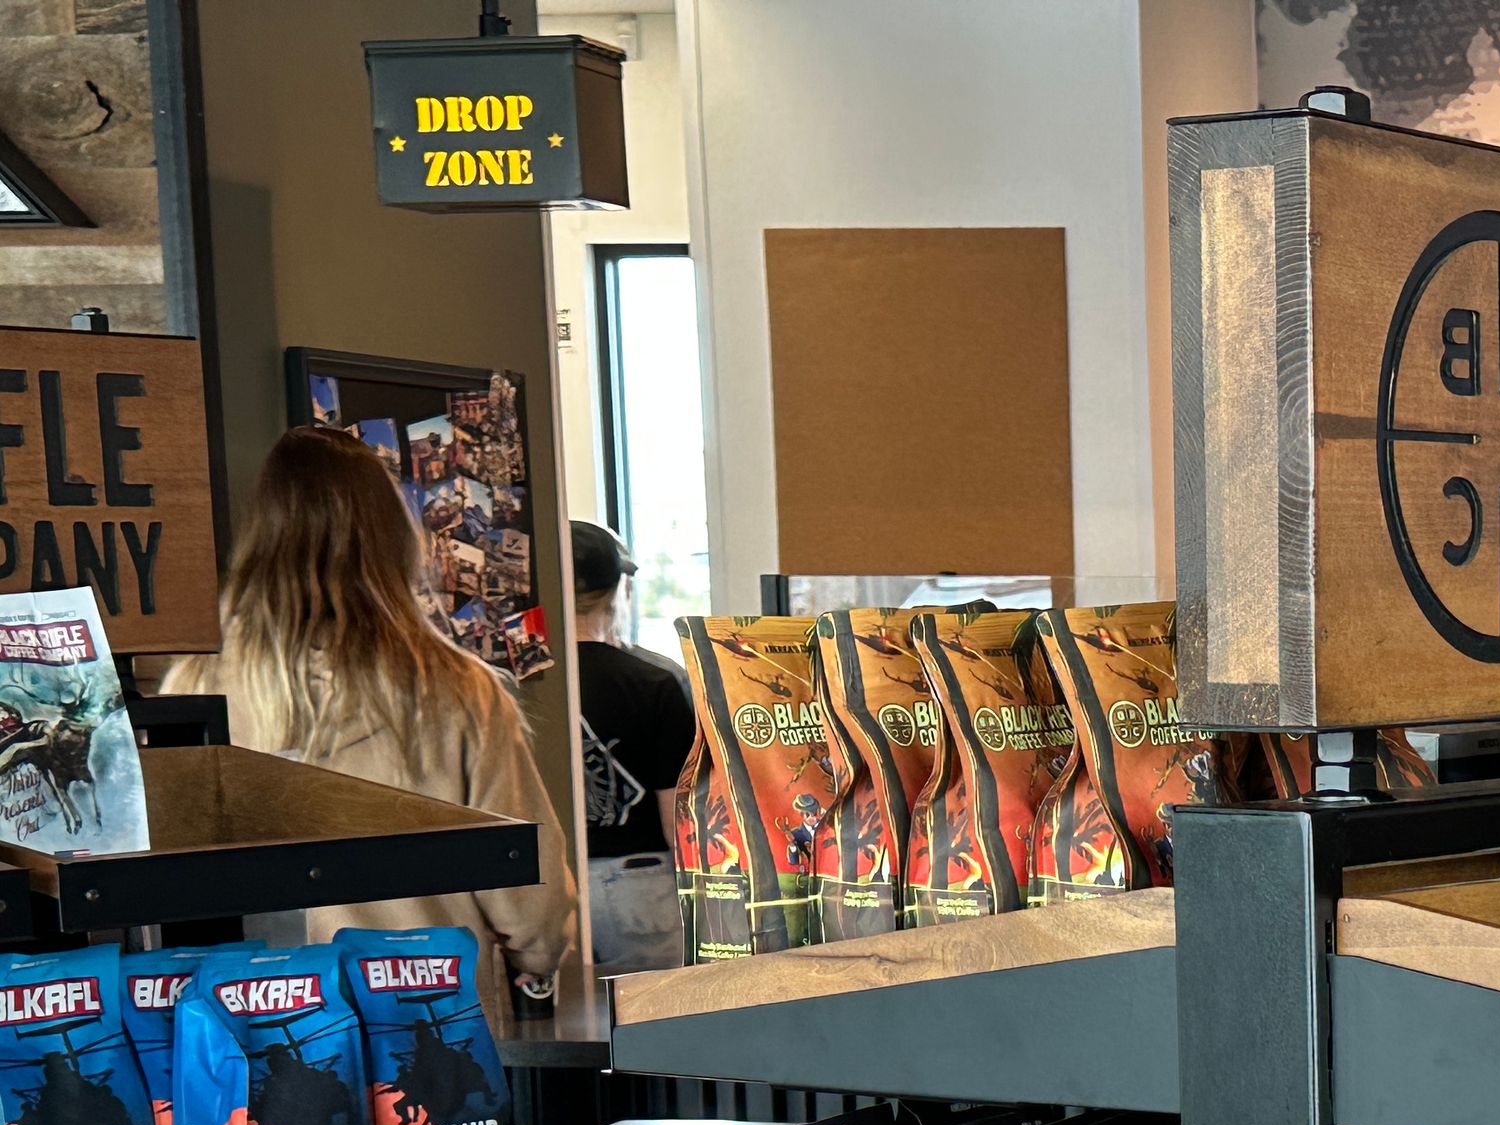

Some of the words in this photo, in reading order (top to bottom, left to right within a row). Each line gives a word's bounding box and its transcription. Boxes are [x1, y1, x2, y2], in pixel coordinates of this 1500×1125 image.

[416, 94, 533, 134] DROP
[423, 149, 534, 187] ZONE
[773, 701, 824, 729] BLAC
